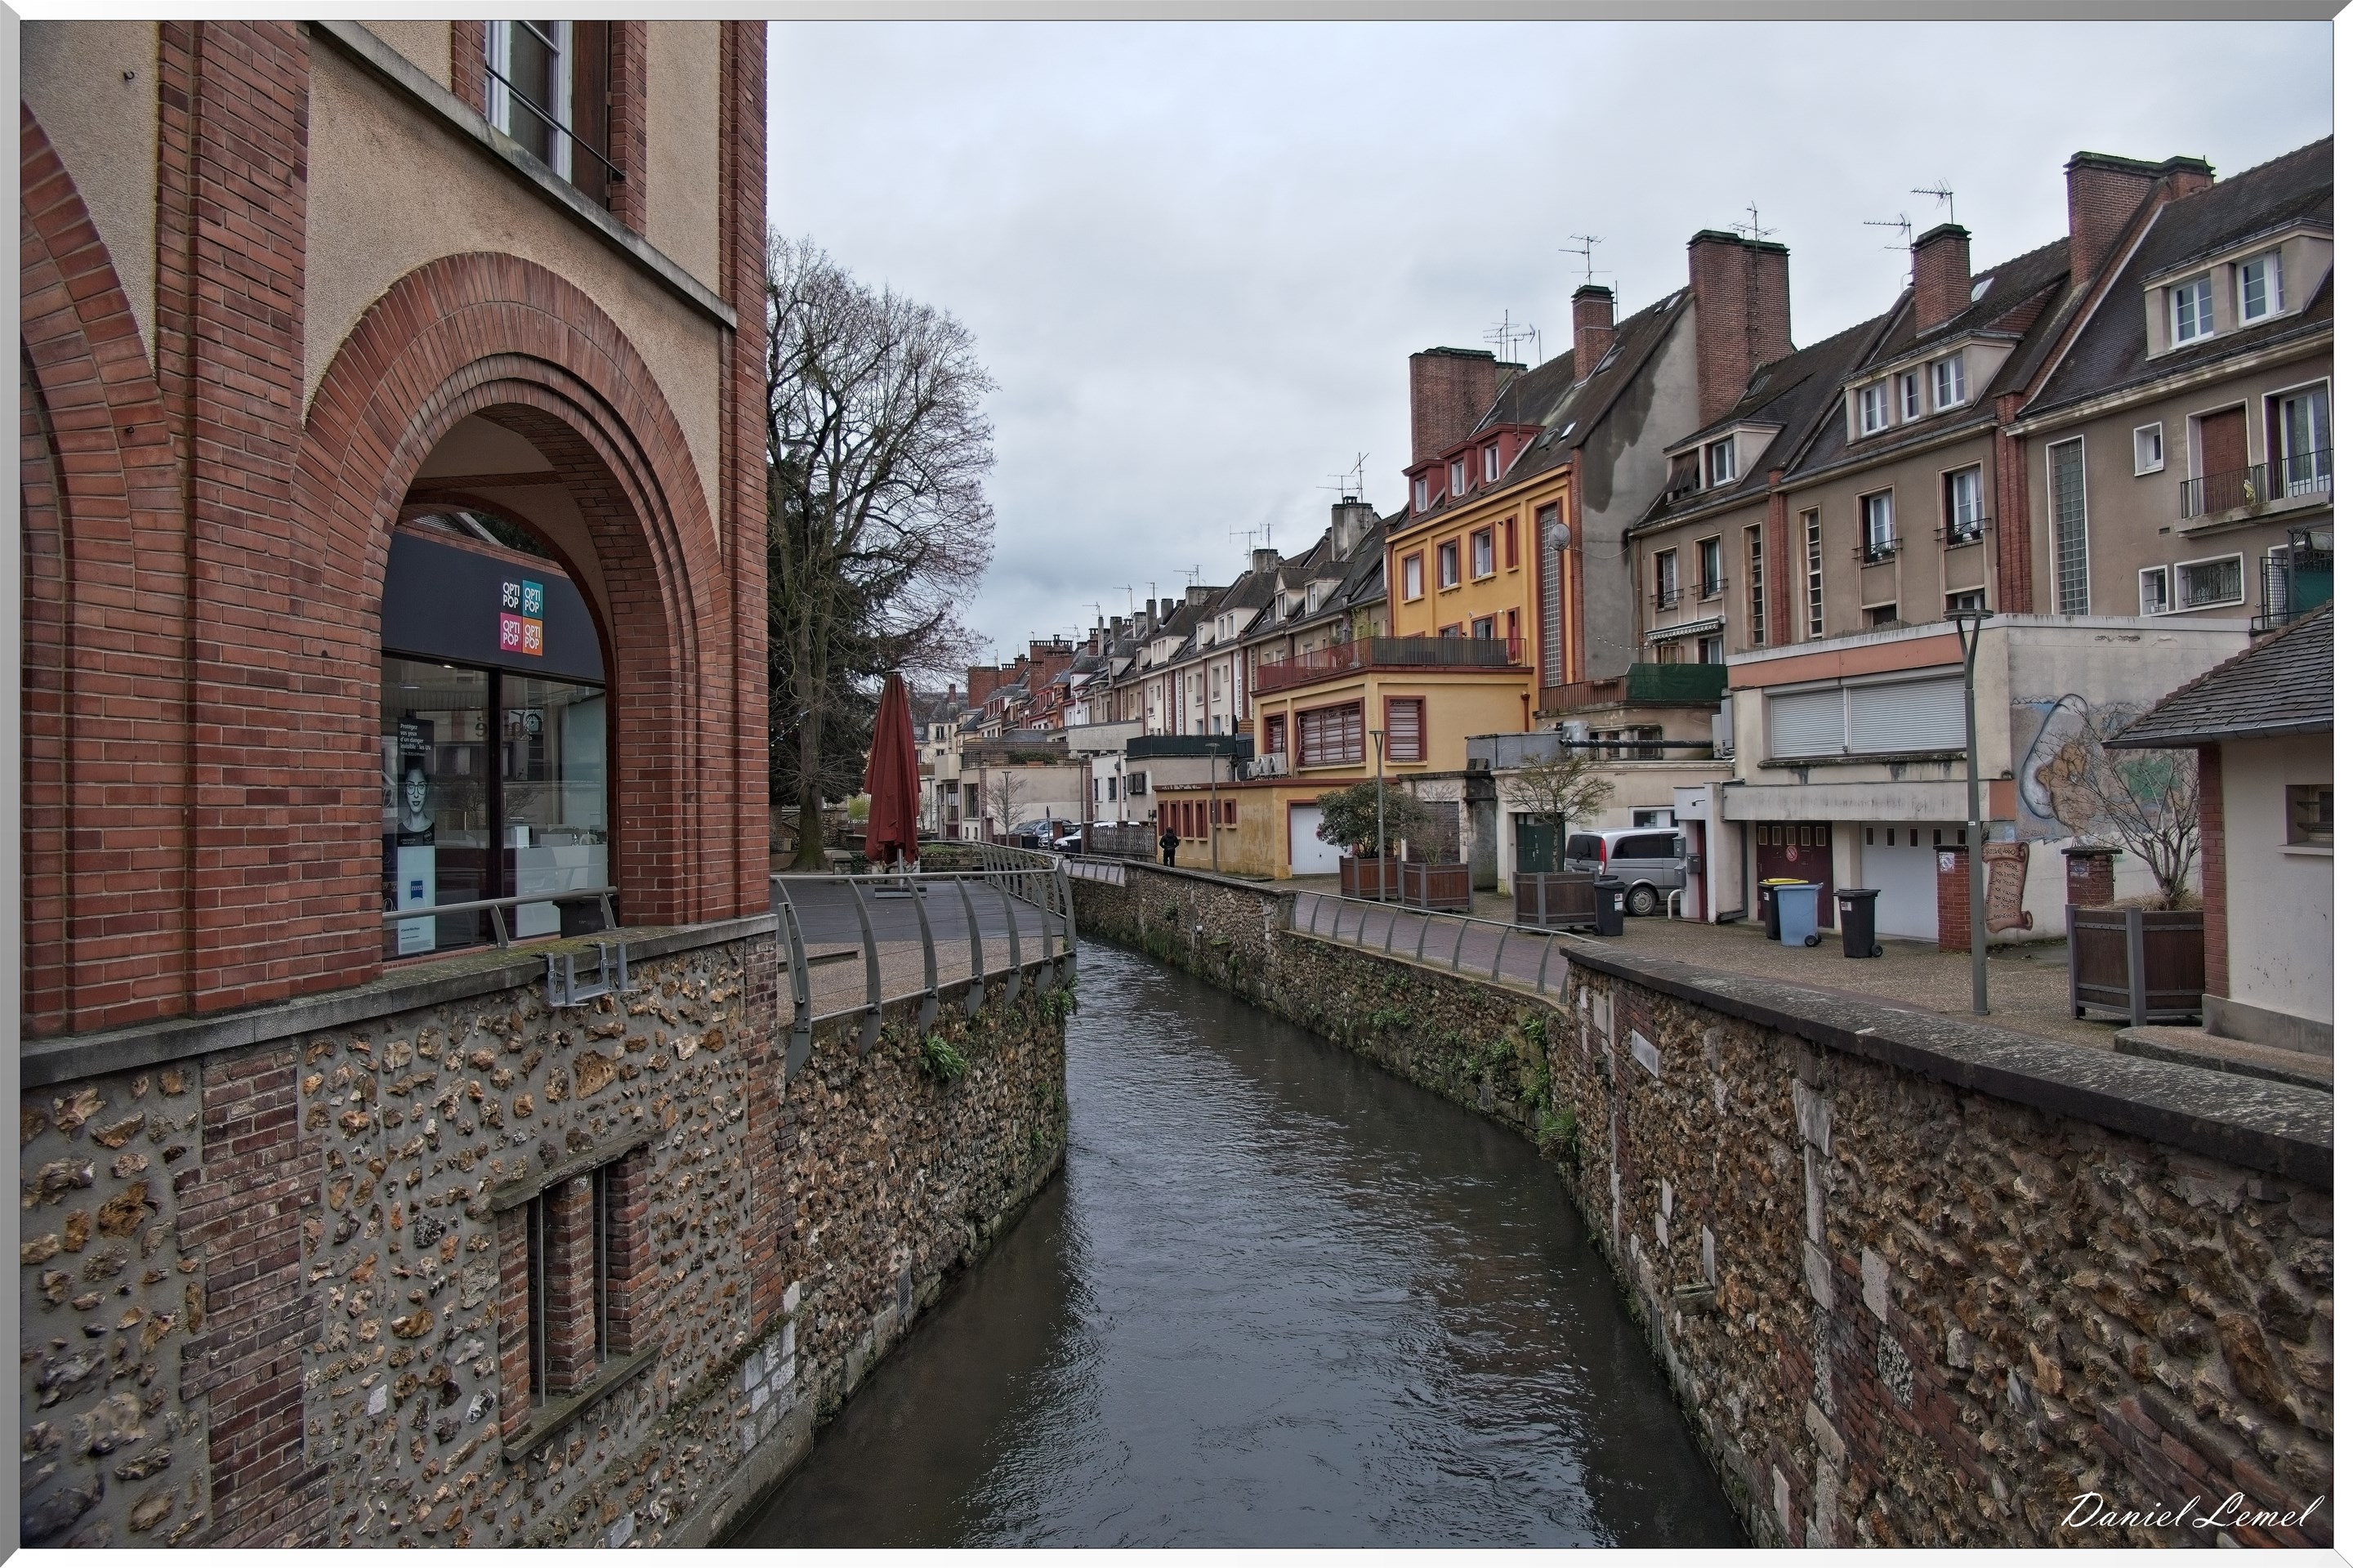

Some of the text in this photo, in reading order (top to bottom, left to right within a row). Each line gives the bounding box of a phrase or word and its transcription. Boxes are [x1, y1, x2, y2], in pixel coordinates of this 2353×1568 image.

[503, 582, 520, 596] OPTI
[524, 587, 541, 602] OPTI
[503, 595, 519, 608] POP
[525, 601, 539, 613] POP
[503, 620, 520, 633] OPTI
[525, 623, 541, 638] OPTI
[503, 632, 519, 646] POP
[525, 637, 540, 650] POP
